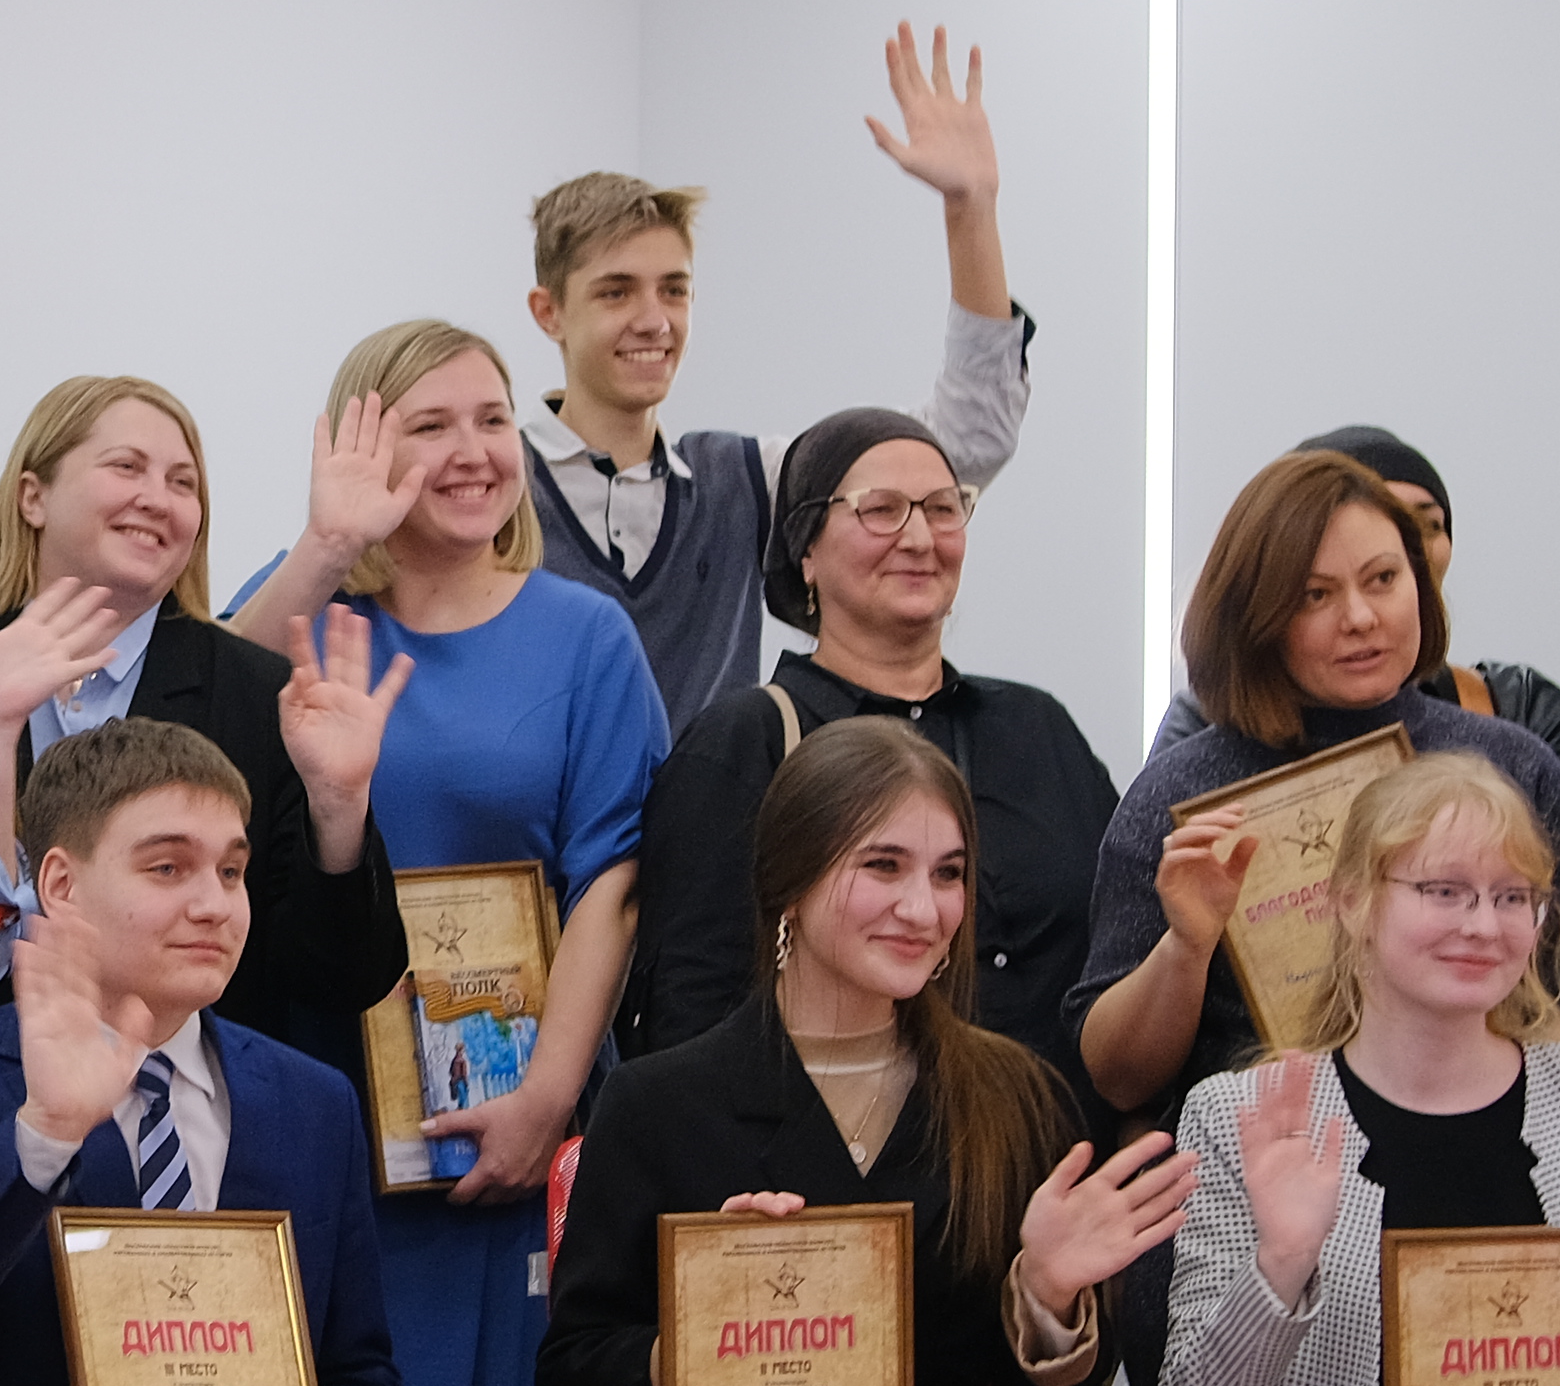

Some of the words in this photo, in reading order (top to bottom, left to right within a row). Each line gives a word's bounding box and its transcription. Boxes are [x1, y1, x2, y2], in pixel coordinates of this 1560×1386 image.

[452, 978, 503, 997] ПОЛК
[122, 1320, 255, 1357] ДИПЛОМ
[717, 1313, 855, 1360] ДИПЛОМ
[179, 1362, 218, 1377] МЕСТО
[772, 1360, 812, 1375] МЕСТО
